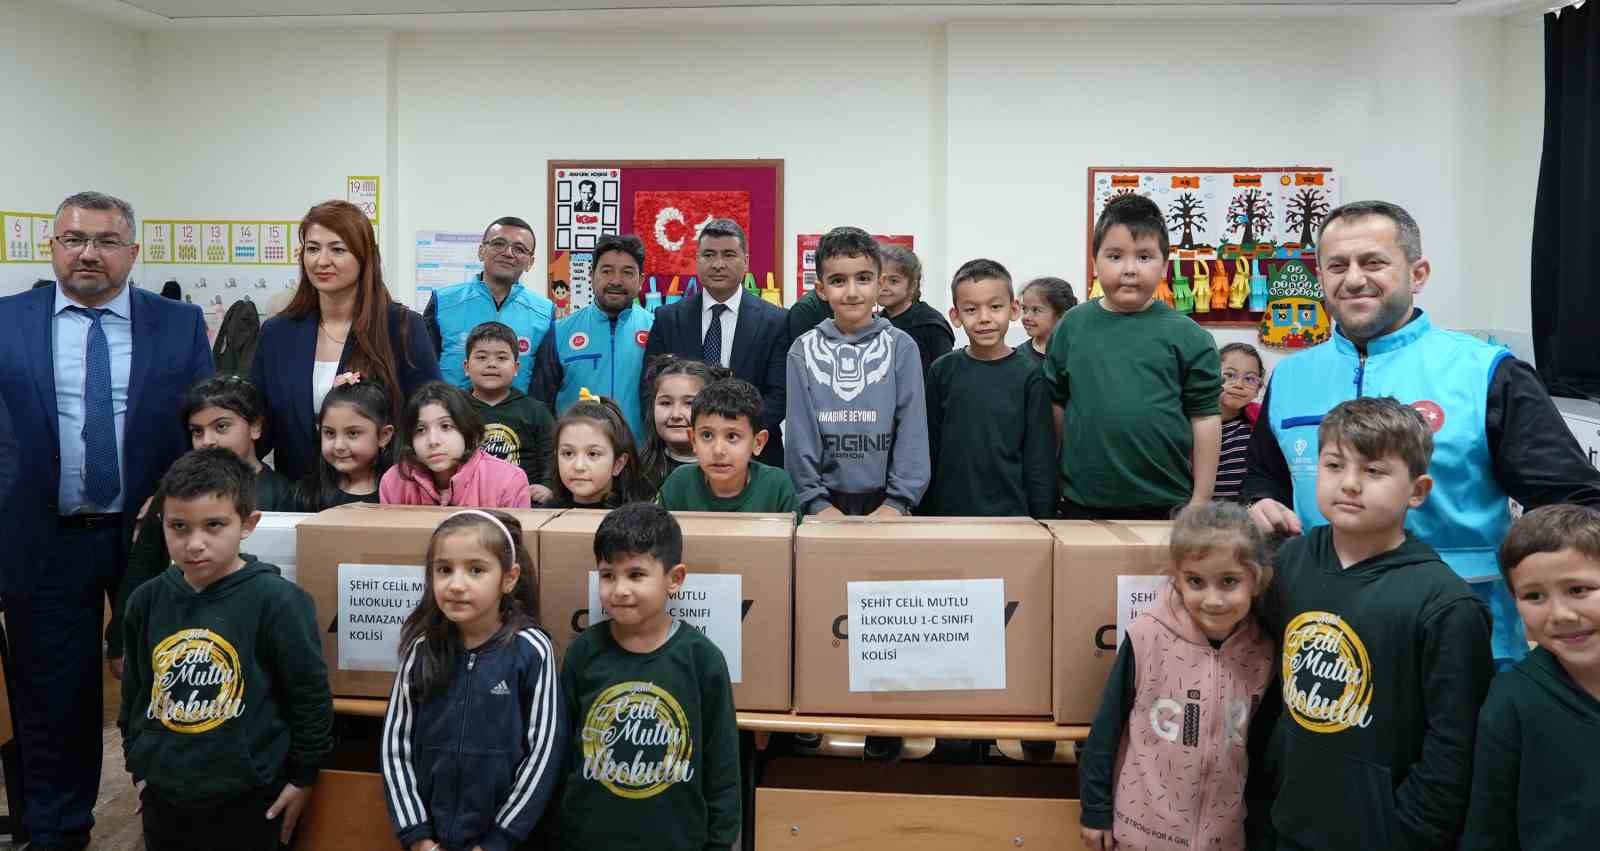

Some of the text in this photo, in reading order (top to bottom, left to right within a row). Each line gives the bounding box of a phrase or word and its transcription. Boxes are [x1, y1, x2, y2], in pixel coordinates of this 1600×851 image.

[351, 180, 361, 193] 19
[14, 218, 22, 232] 6
[154, 226, 162, 238] 11
[182, 226, 193, 238] 12
[211, 226, 221, 238] 13
[240, 226, 251, 238] 14
[269, 226, 280, 238] 15
[818, 410, 877, 422] IMAGINE BEYOND
[350, 579, 380, 591] ŞEHİT
[382, 580, 409, 592] CELİL
[350, 595, 402, 608] İLKOKULU
[860, 595, 968, 610] ŞEHİT CELİL MUTLU
[679, 607, 711, 618] SINIFI
[350, 614, 405, 625] RAMAZAN
[861, 614, 973, 625] İLKOKULU 1-C SINIFI
[350, 629, 383, 641] KOLİSİ
[861, 632, 969, 643] RAMAZAN YARDIM
[861, 648, 897, 660] KOLİSİ
[1290, 650, 1362, 684] Mutlu
[159, 664, 234, 691] Mutlu
[582, 719, 681, 748] Mutlu
